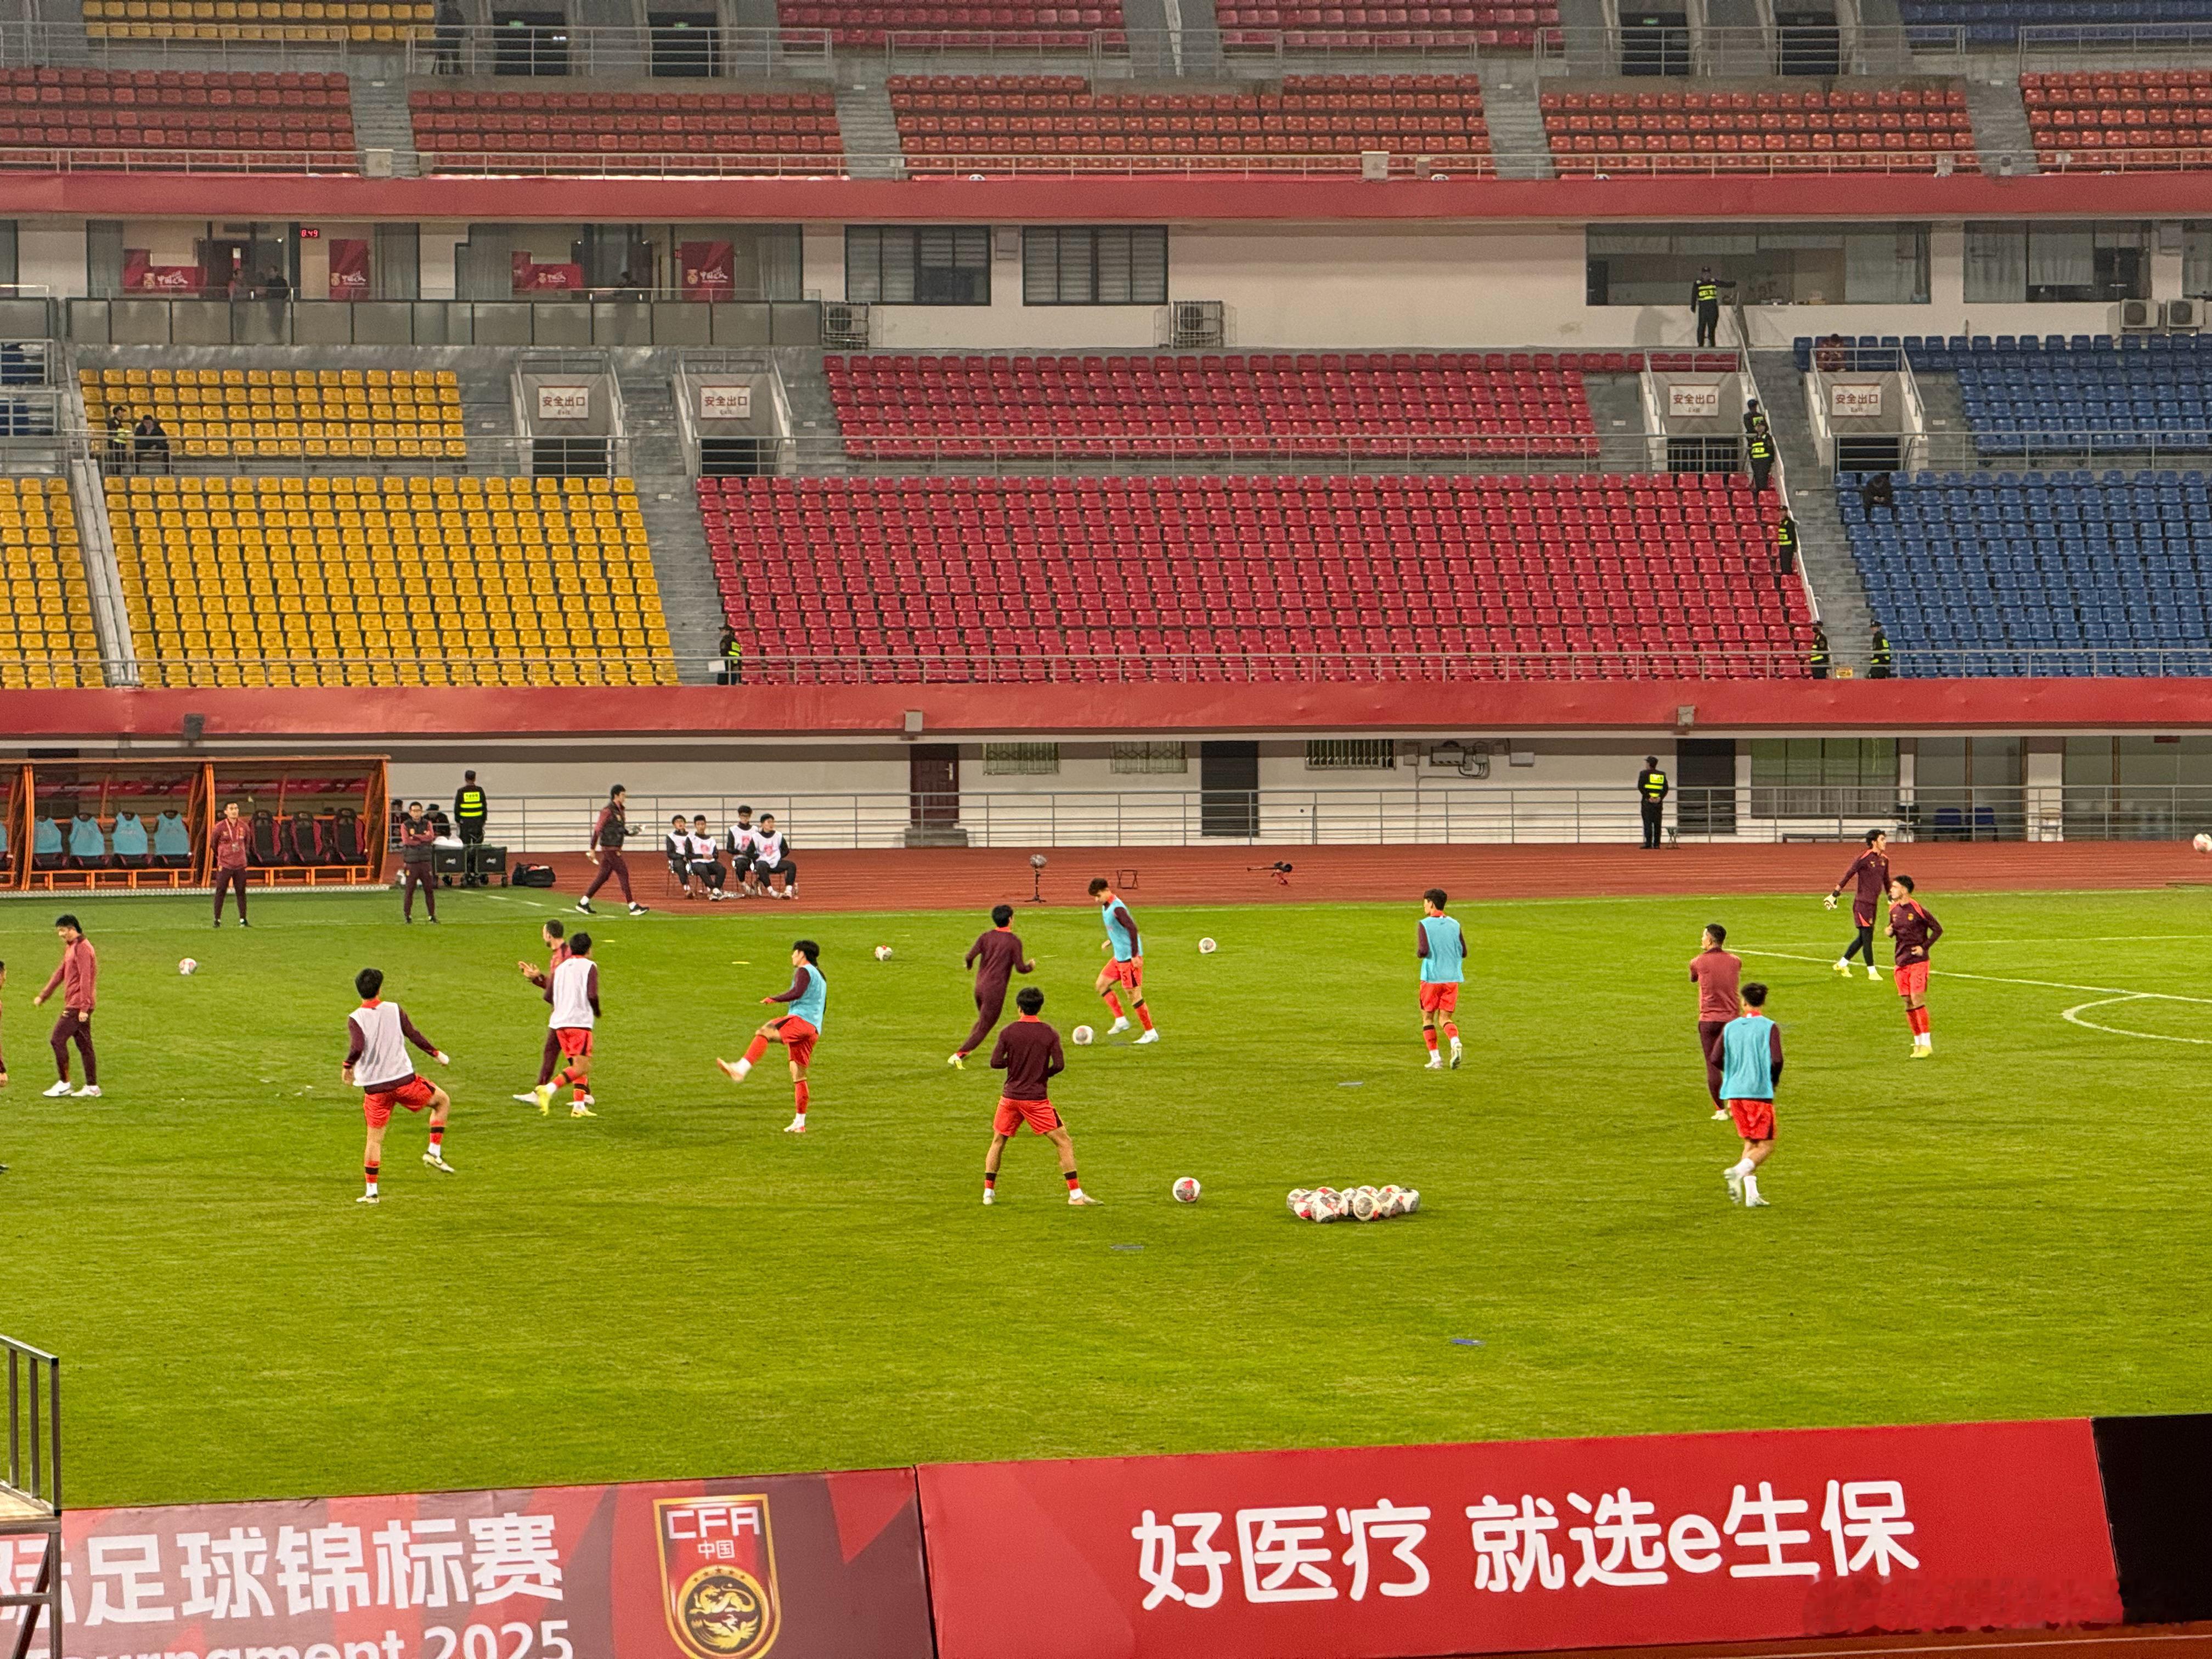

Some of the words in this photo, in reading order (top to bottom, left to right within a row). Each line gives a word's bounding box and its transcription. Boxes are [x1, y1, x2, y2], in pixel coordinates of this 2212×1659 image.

[543, 396, 585, 407] 安全出口
[704, 396, 747, 407] 安全出口
[1673, 394, 1716, 404] 安全出口
[1835, 393, 1878, 404] 安全出口
[666, 1506, 760, 1539] CFA
[697, 1539, 735, 1560] 中国
[1131, 1497, 1431, 1611] 好医疗
[1465, 1479, 1920, 1594] 就选e生保
[424, 1620, 574, 1659] 2025
